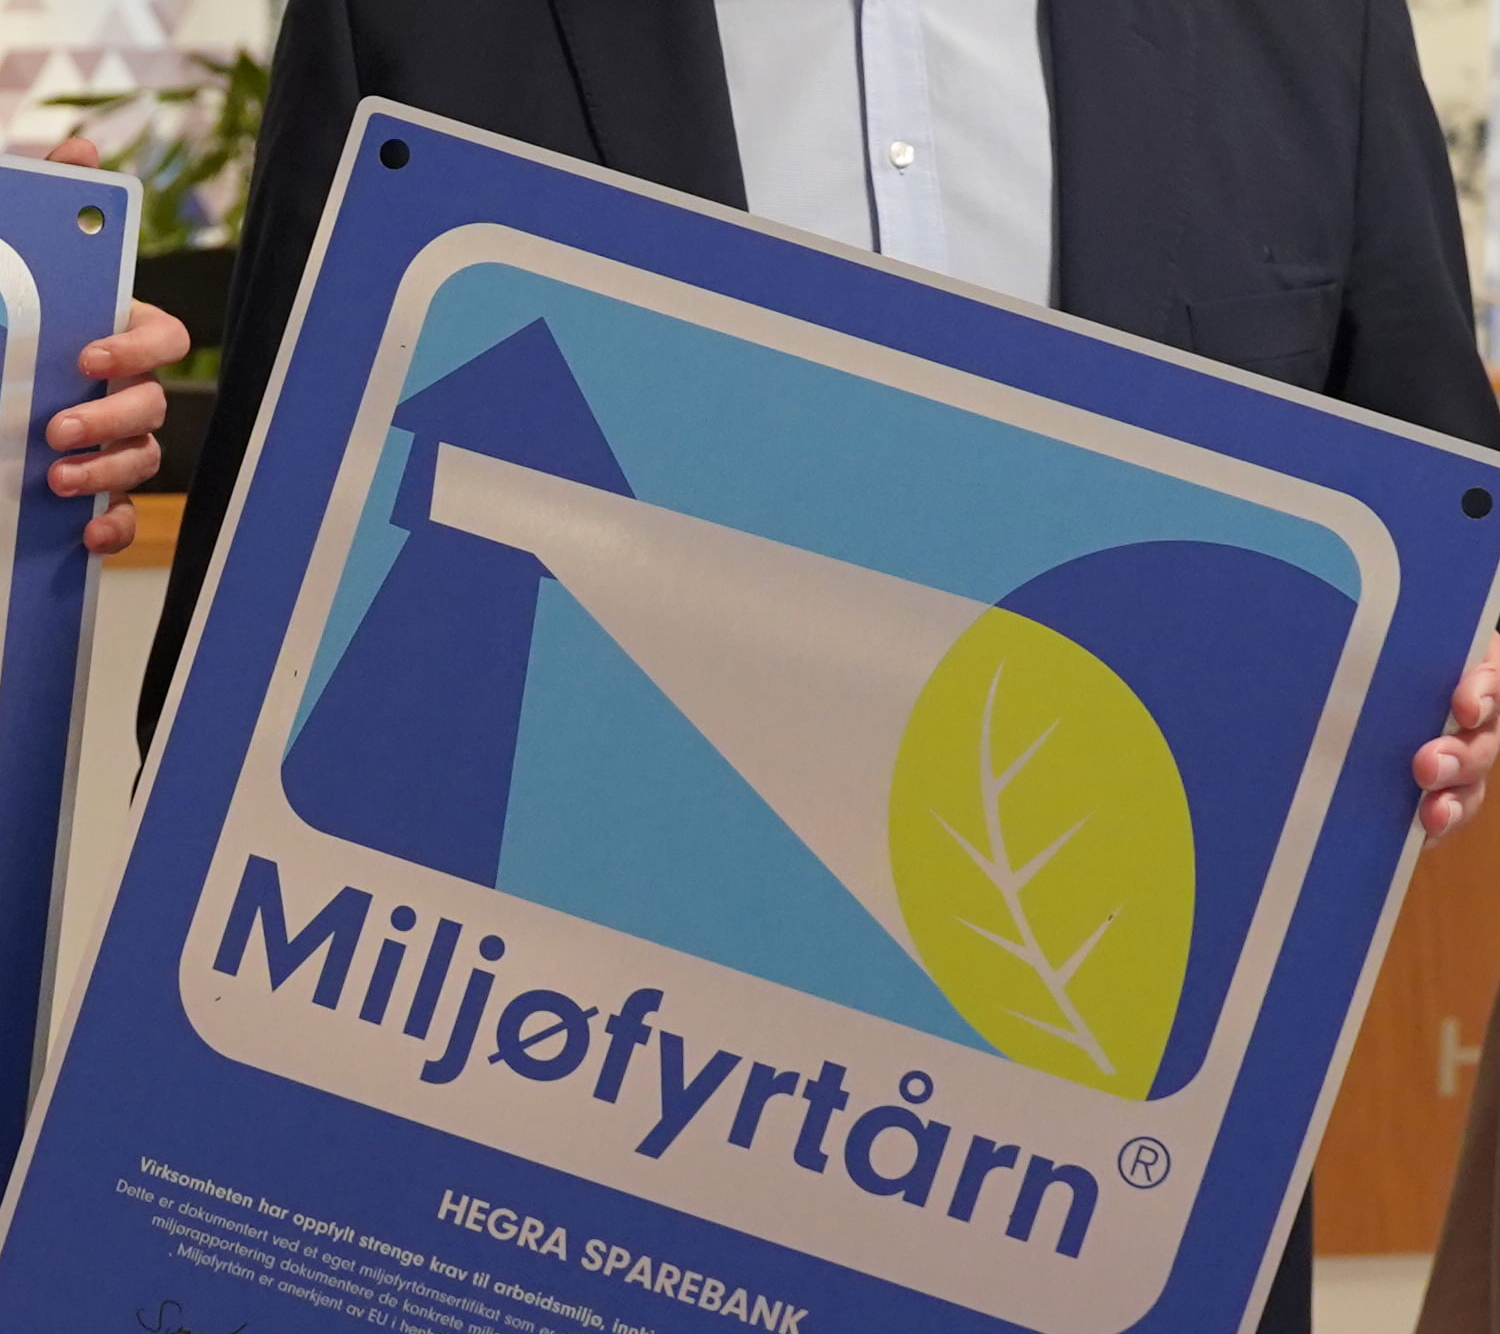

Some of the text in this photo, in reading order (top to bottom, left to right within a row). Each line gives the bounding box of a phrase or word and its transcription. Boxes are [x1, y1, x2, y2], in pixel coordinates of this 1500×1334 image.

[139, 1154, 254, 1209] Virksomheten
[256, 1196, 290, 1220] har
[291, 1212, 356, 1244] oppfylt
[357, 1234, 425, 1267] strenge
[428, 1254, 469, 1282] krav
[470, 1270, 491, 1289] til
[436, 1187, 567, 1262] HEGRA
